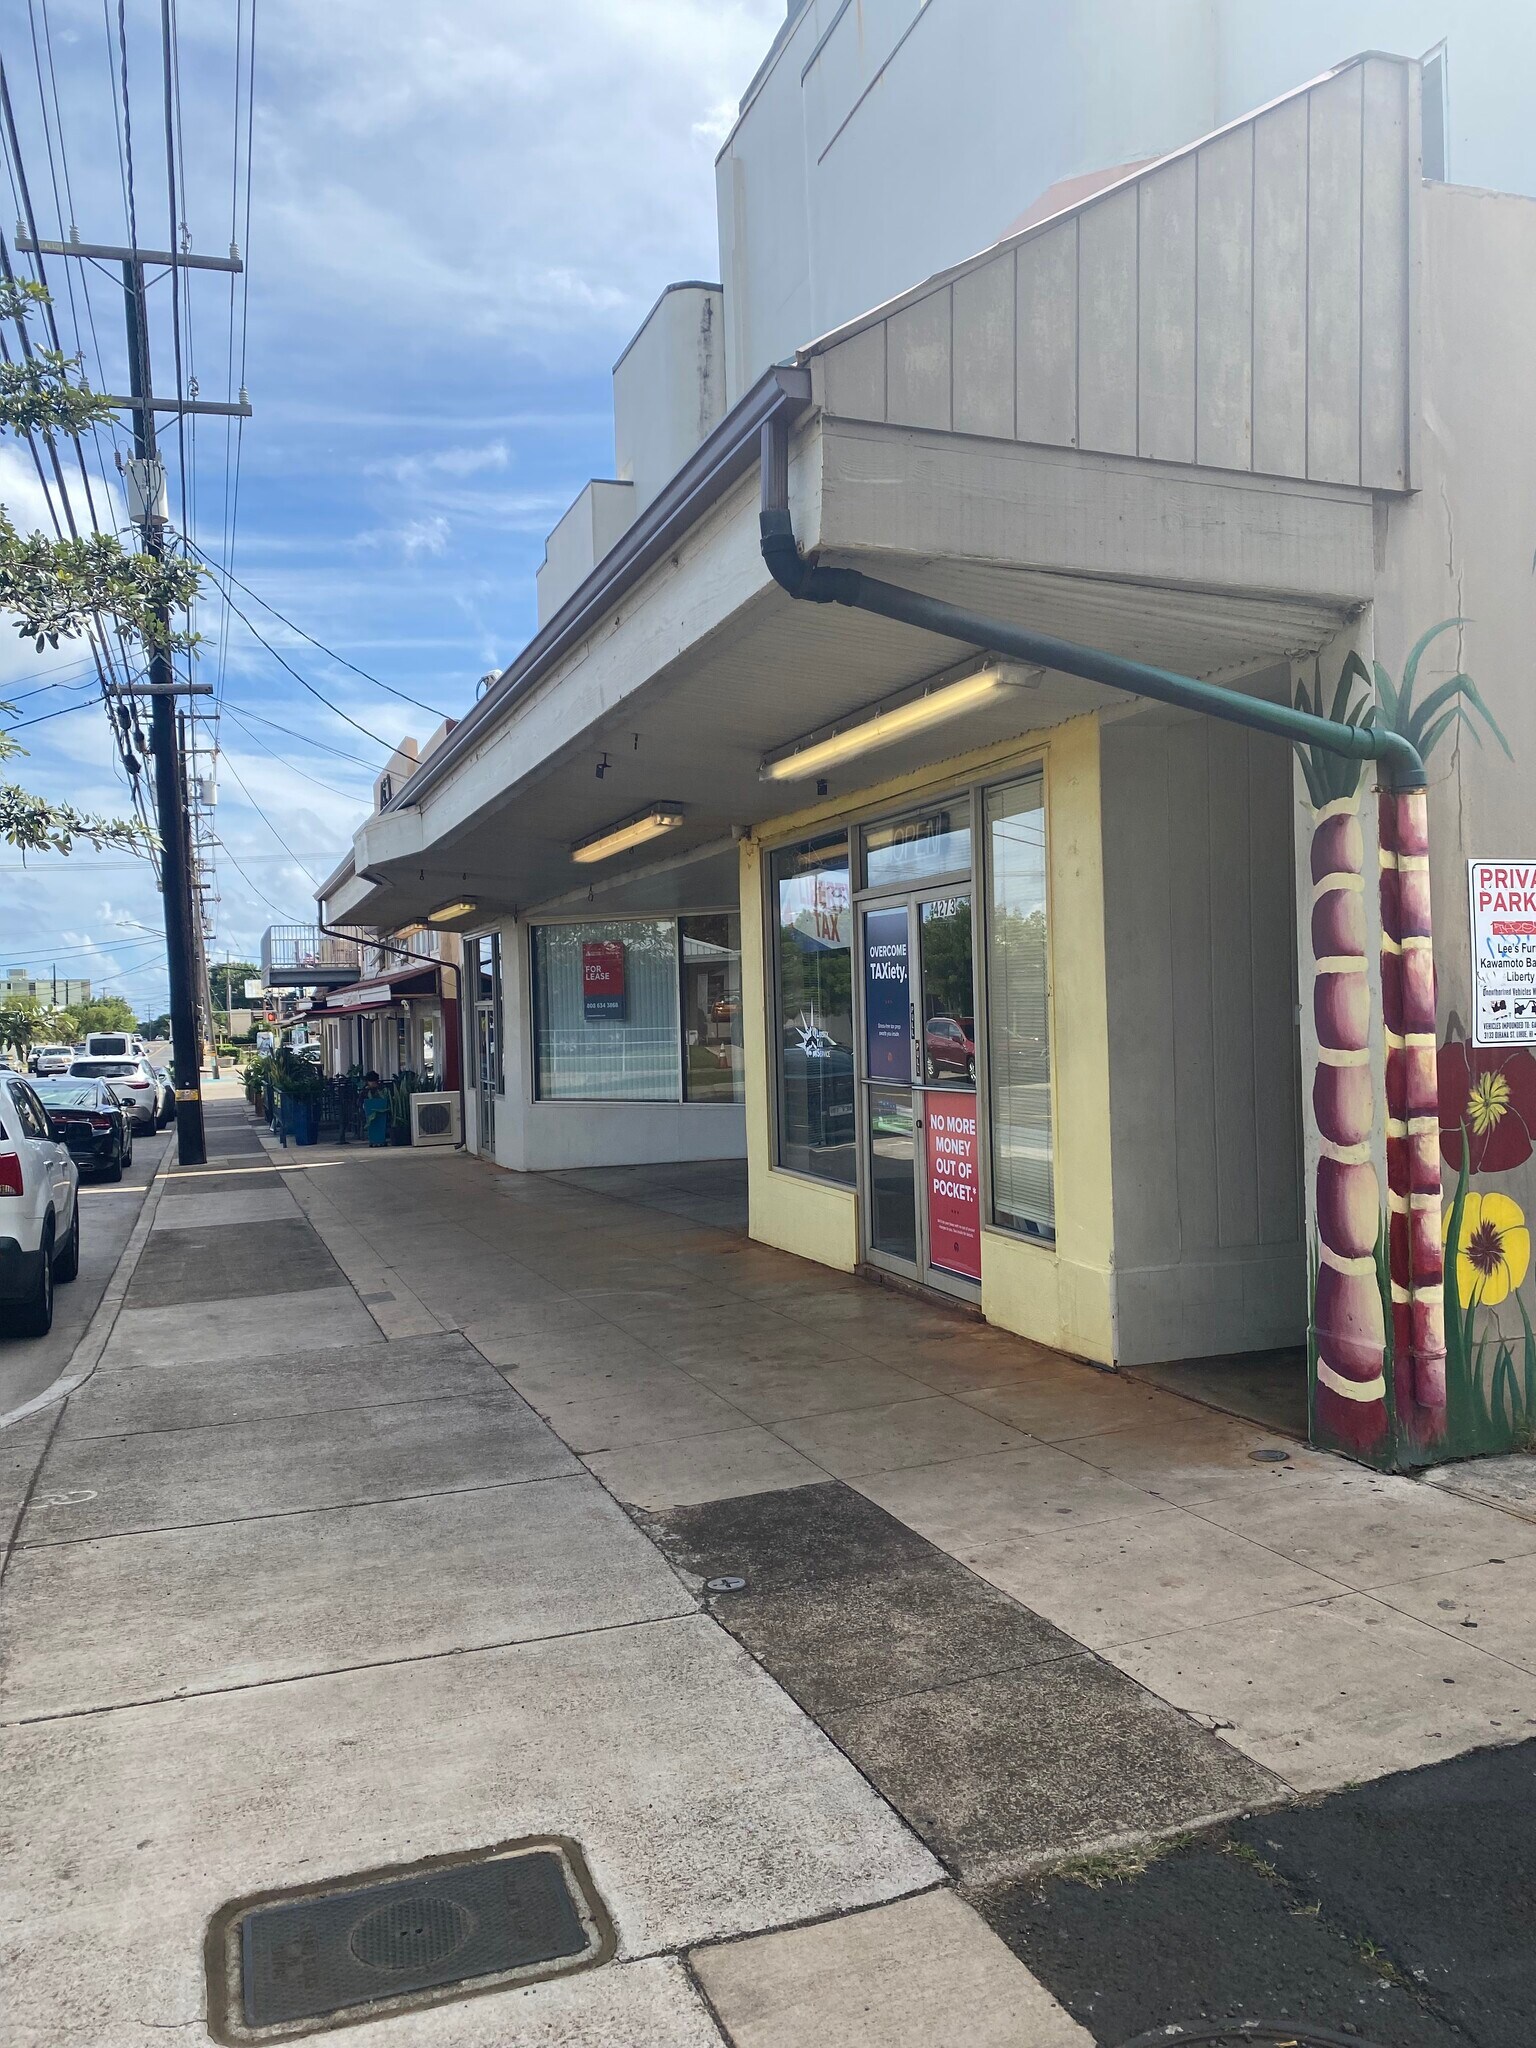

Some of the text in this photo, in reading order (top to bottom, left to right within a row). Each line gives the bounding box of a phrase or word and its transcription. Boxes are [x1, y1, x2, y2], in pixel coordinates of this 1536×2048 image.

[893, 821, 939, 861] OPEN
[934, 899, 956, 917] 4273
[869, 943, 907, 958] OVERCOME
[1497, 943, 1520, 954] Lee's
[585, 965, 602, 973] FOR
[1480, 958, 1524, 969] Kawamoto
[585, 973, 610, 981] LEASE
[870, 962, 908, 983] TAXiety.
[1507, 971, 1535, 984] Liberty
[930, 1114, 976, 1136] NO MORE
[935, 1136, 971, 1157] MONEY
[936, 1158, 972, 1179] OUT OF
